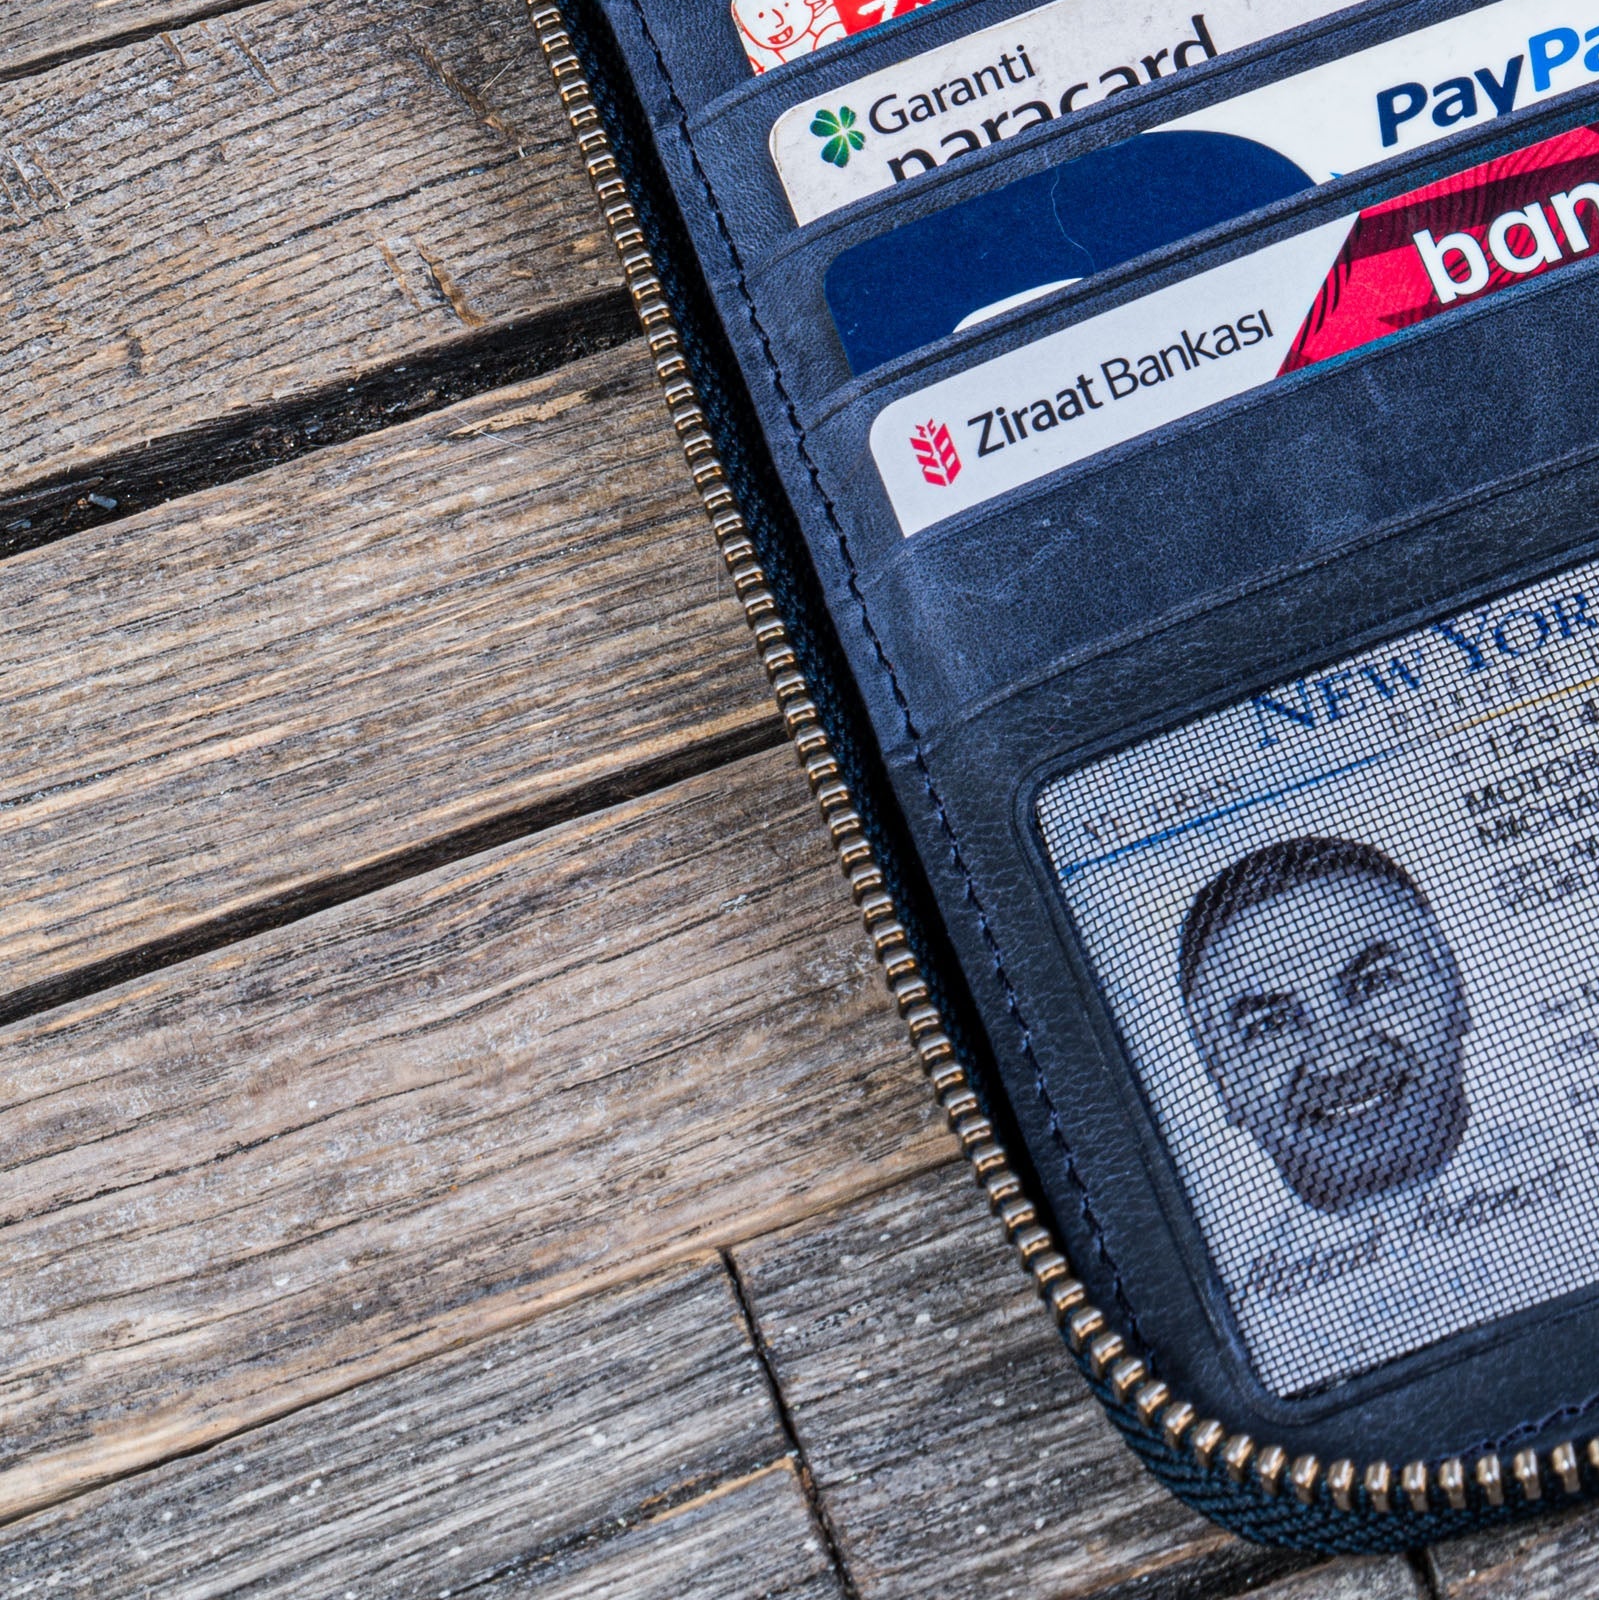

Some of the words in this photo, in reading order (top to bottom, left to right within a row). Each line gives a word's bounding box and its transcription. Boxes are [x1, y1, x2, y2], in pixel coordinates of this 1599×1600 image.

[868, 44, 1036, 135] Garanti
[966, 373, 1103, 458] Ziraat
[1100, 308, 1275, 399] Bankası
[1248, 659, 1434, 748] NEW
